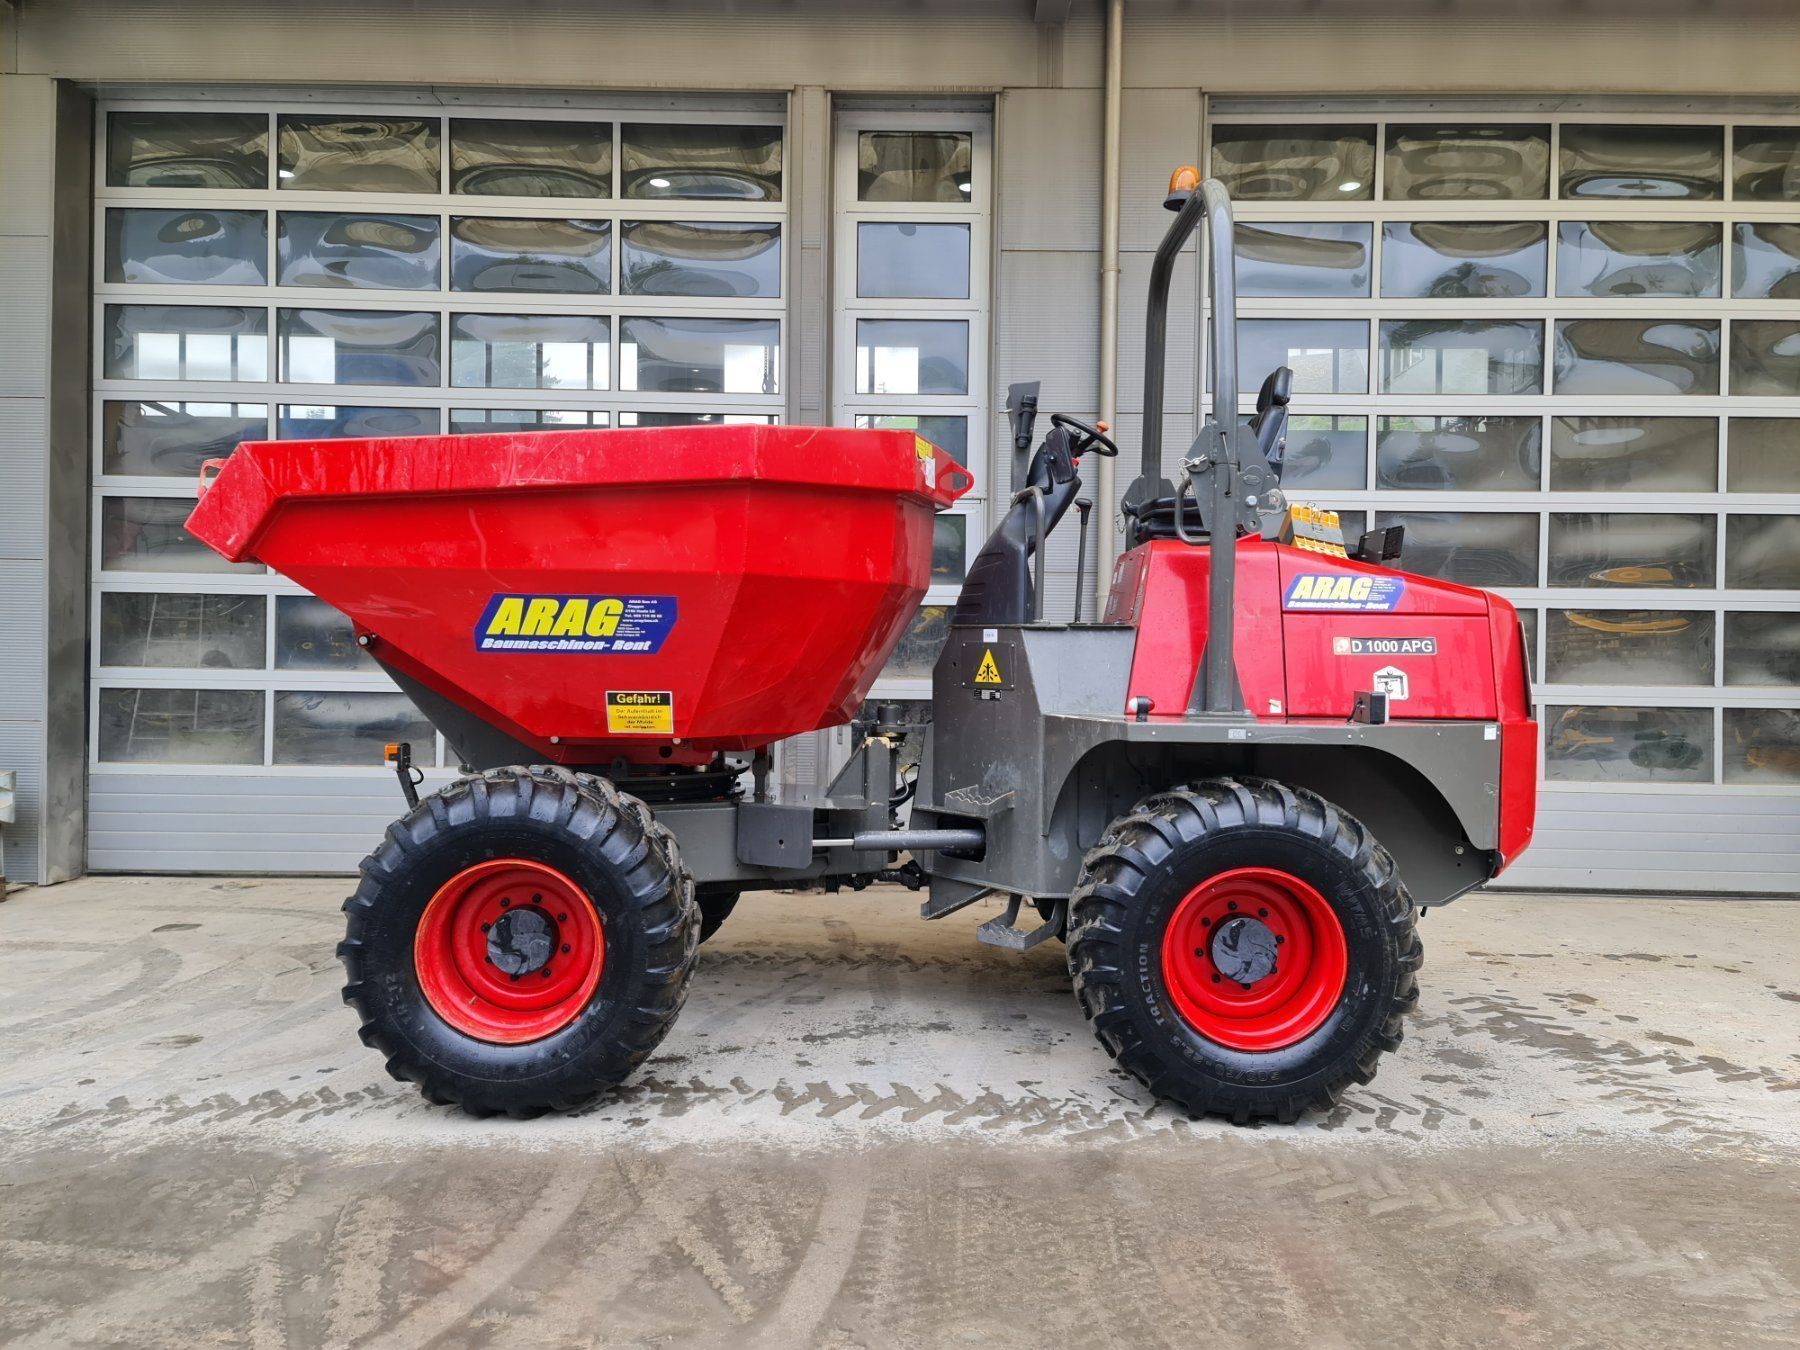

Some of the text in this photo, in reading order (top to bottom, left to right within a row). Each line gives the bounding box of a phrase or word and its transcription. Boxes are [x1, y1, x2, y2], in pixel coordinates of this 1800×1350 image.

[1290, 576, 1373, 600] ARAG
[486, 597, 624, 637] ARAG
[612, 639, 652, 651] Rent
[1351, 640, 1433, 653] D 1000 APG
[616, 693, 661, 704] Gefahr!
[1138, 943, 1165, 1026] TRACTION
